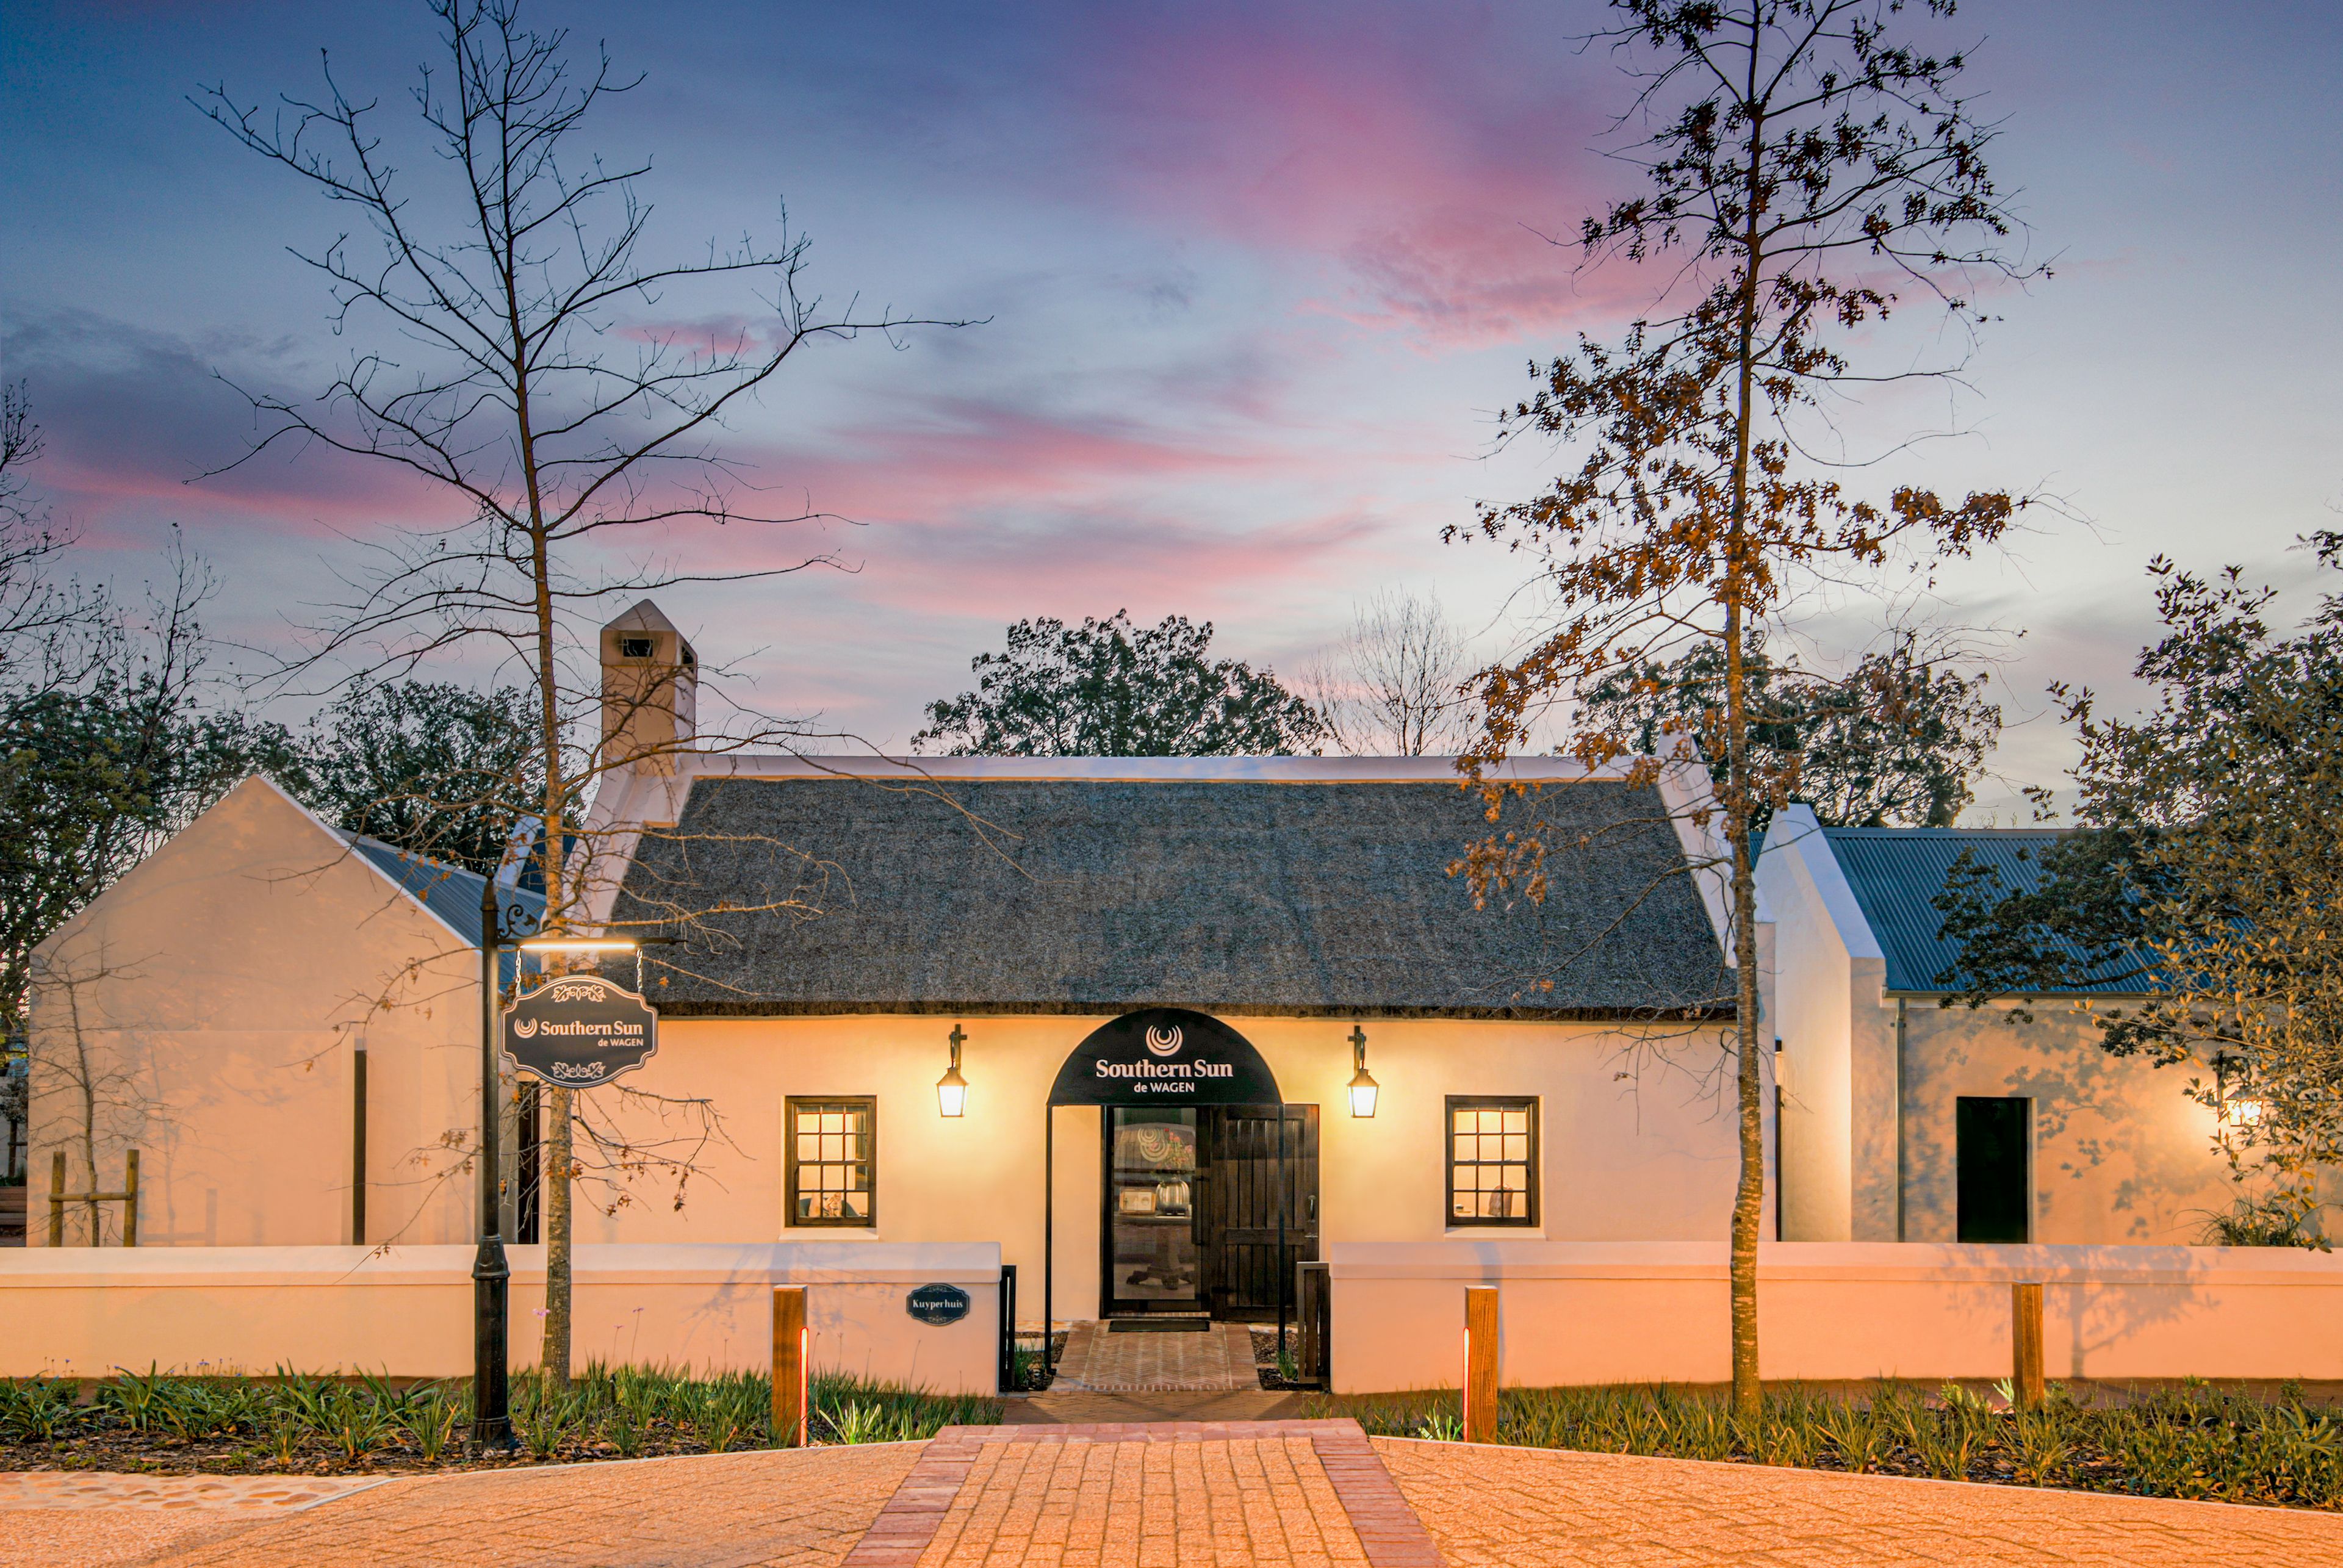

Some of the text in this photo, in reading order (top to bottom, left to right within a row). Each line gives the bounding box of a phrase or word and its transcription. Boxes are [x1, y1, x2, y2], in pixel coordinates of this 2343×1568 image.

[541, 1020, 642, 1035] Southern Sun
[1096, 1059, 1233, 1078] Southern Sun
[1134, 1082, 1195, 1093] de WAGEN
[913, 1300, 963, 1310] Kuyperhuis
